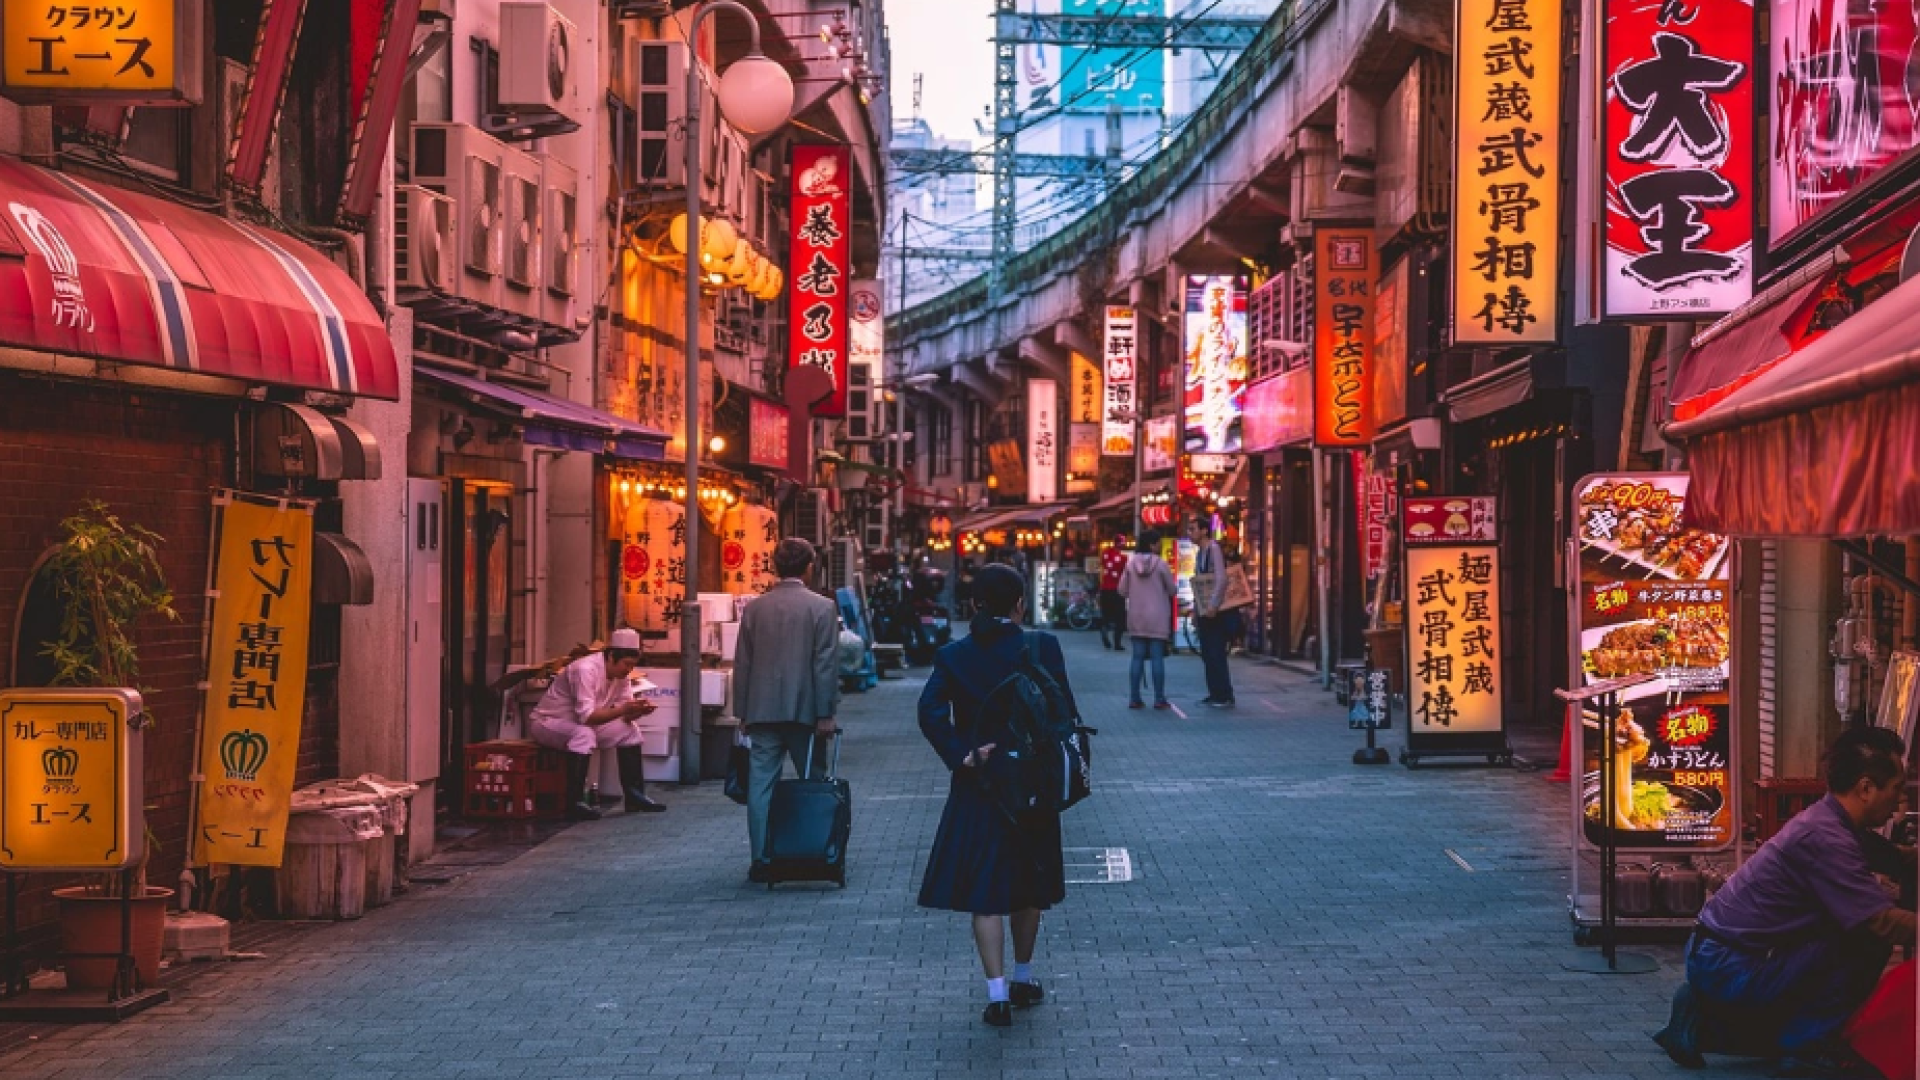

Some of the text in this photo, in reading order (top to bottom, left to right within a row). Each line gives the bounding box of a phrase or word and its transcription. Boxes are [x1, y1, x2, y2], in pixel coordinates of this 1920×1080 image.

[46, 6, 137, 29] クラウン
[25, 36, 155, 78] エース
[1457, 552, 1494, 695] 麺屋武蔵
[1415, 568, 1459, 727] 武骨相傳
[13, 721, 109, 741] カレー専門店
[1666, 713, 1710, 742] 名物
[1648, 751, 1726, 769] かすうどん
[1674, 771, 1724, 786] 580円
[31, 803, 92, 824] エース
